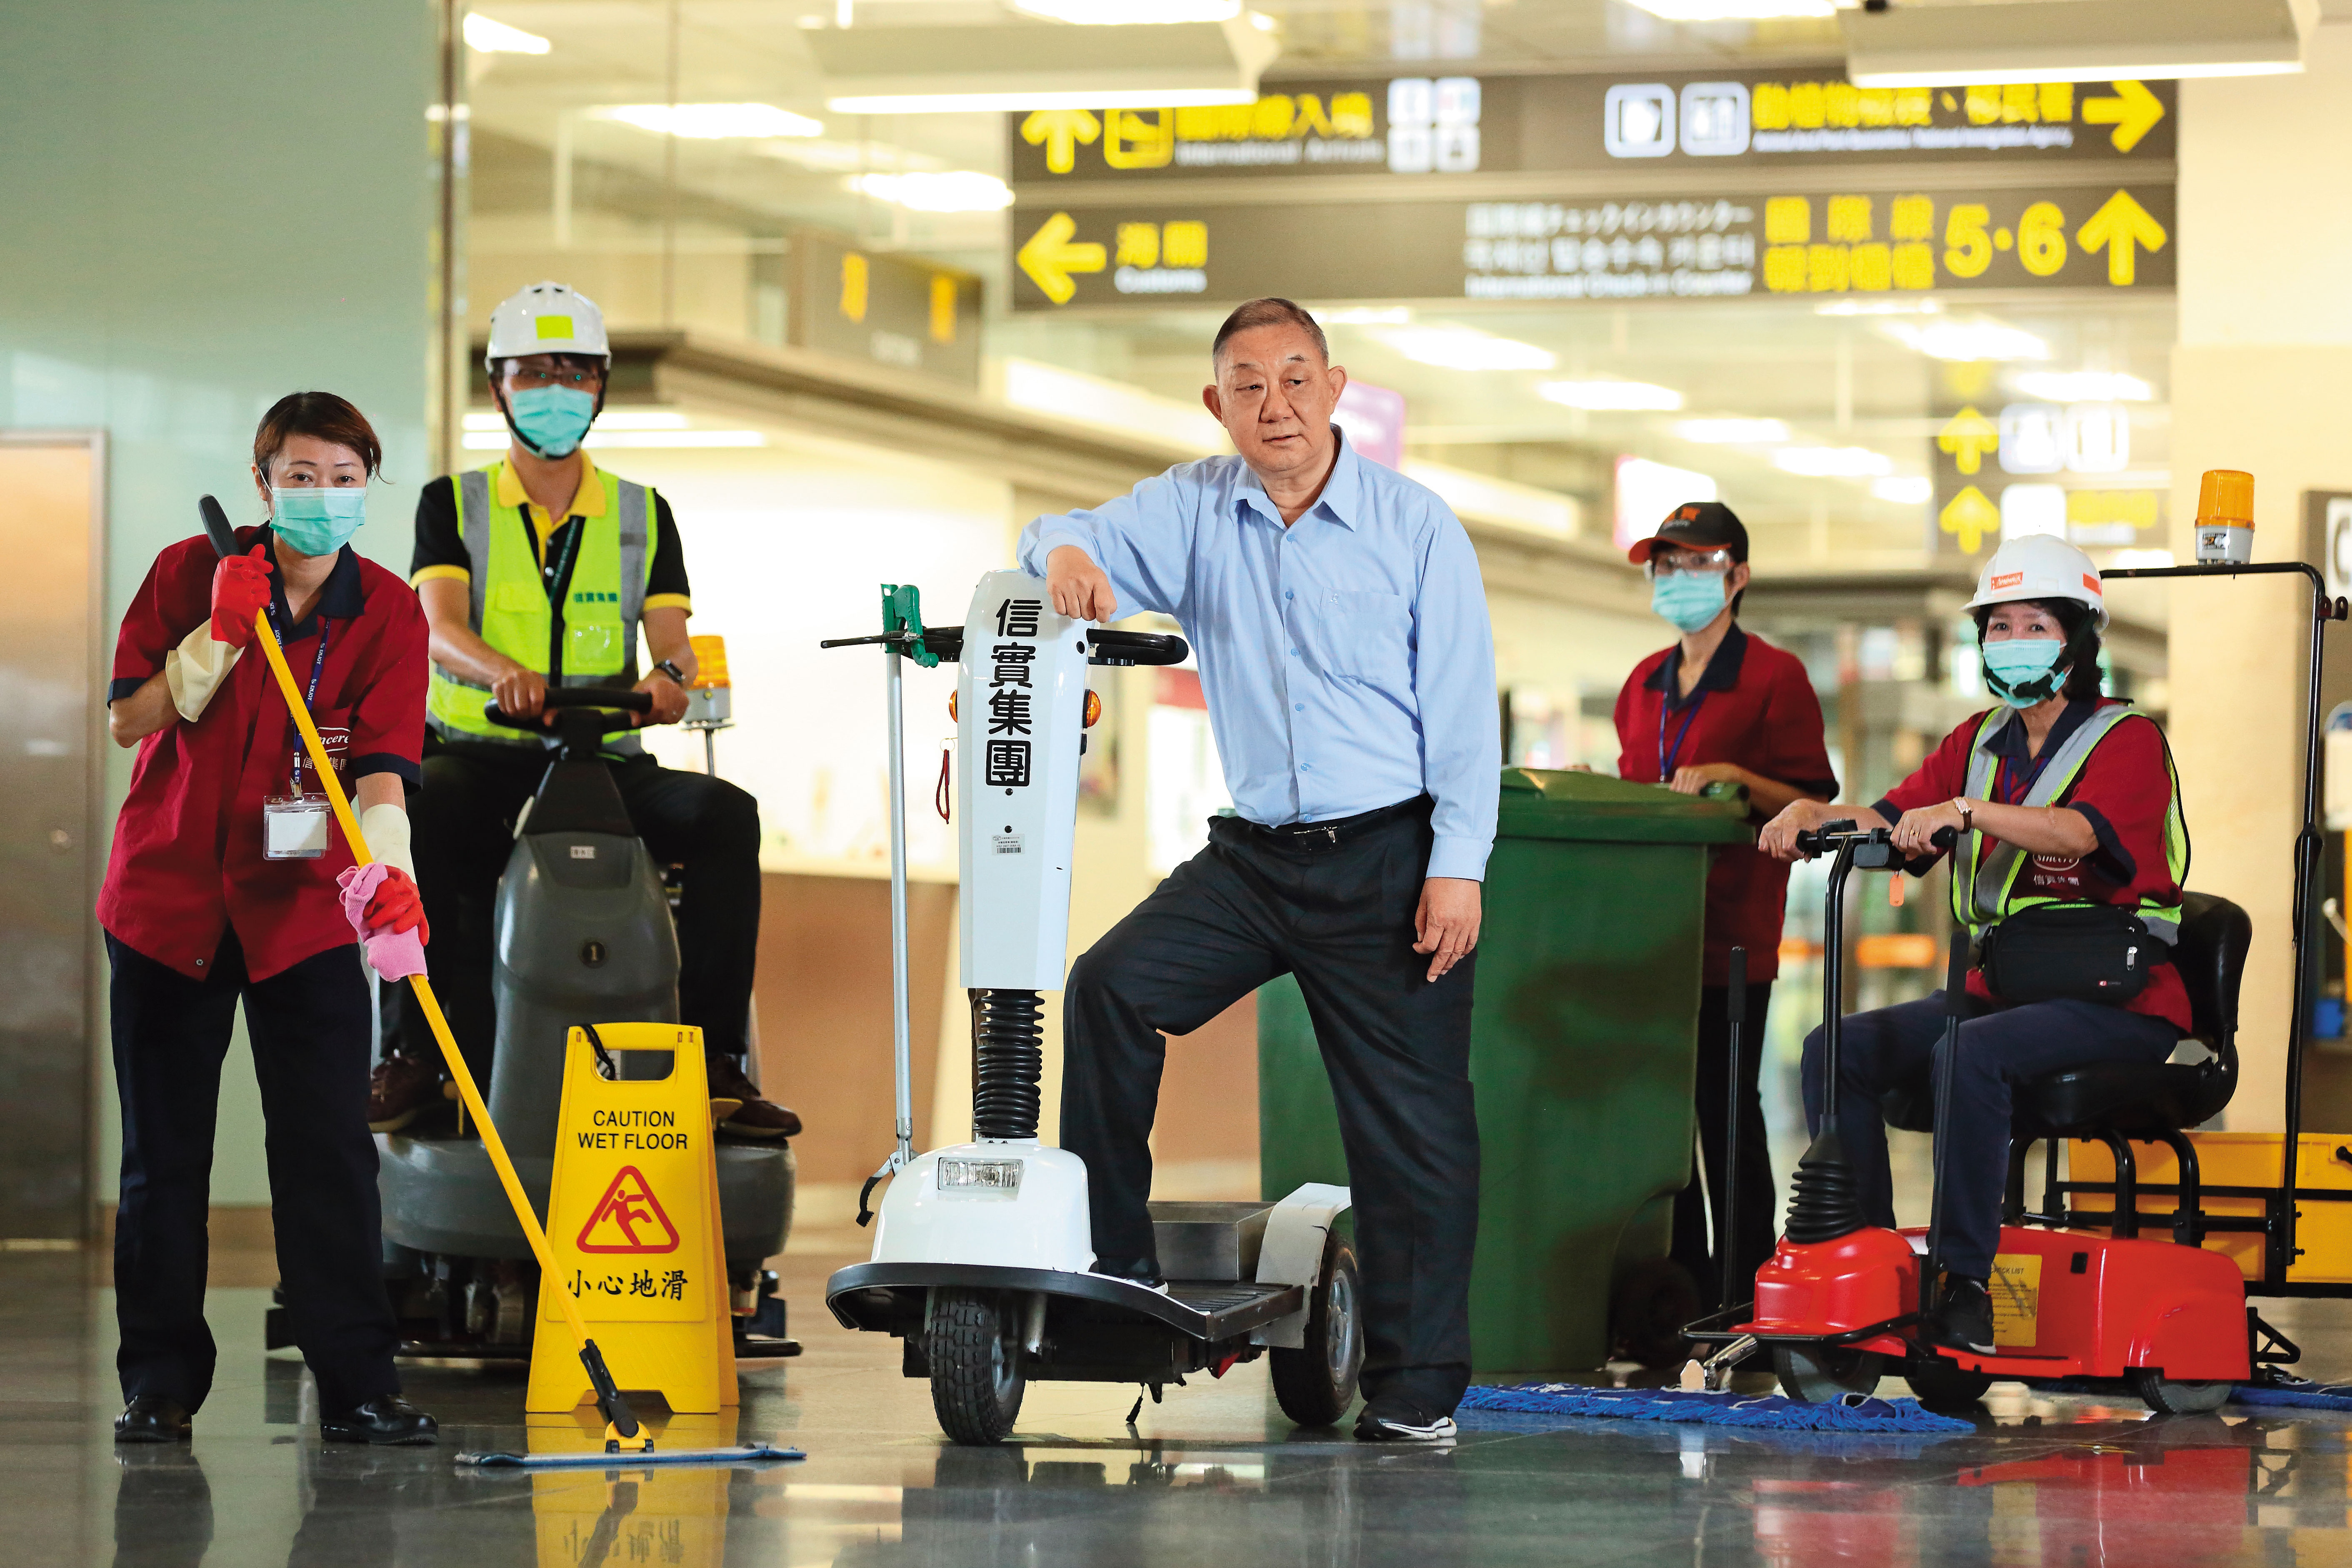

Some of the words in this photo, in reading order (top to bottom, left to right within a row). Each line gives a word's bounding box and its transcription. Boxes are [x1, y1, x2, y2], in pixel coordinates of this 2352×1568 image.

[985, 598, 1043, 787] 信實集團
[593, 1110, 675, 1127] CAUTION
[578, 1133, 619, 1149] WET
[625, 1133, 687, 1150] FLOOR
[567, 1269, 688, 1301] 小心地滑
